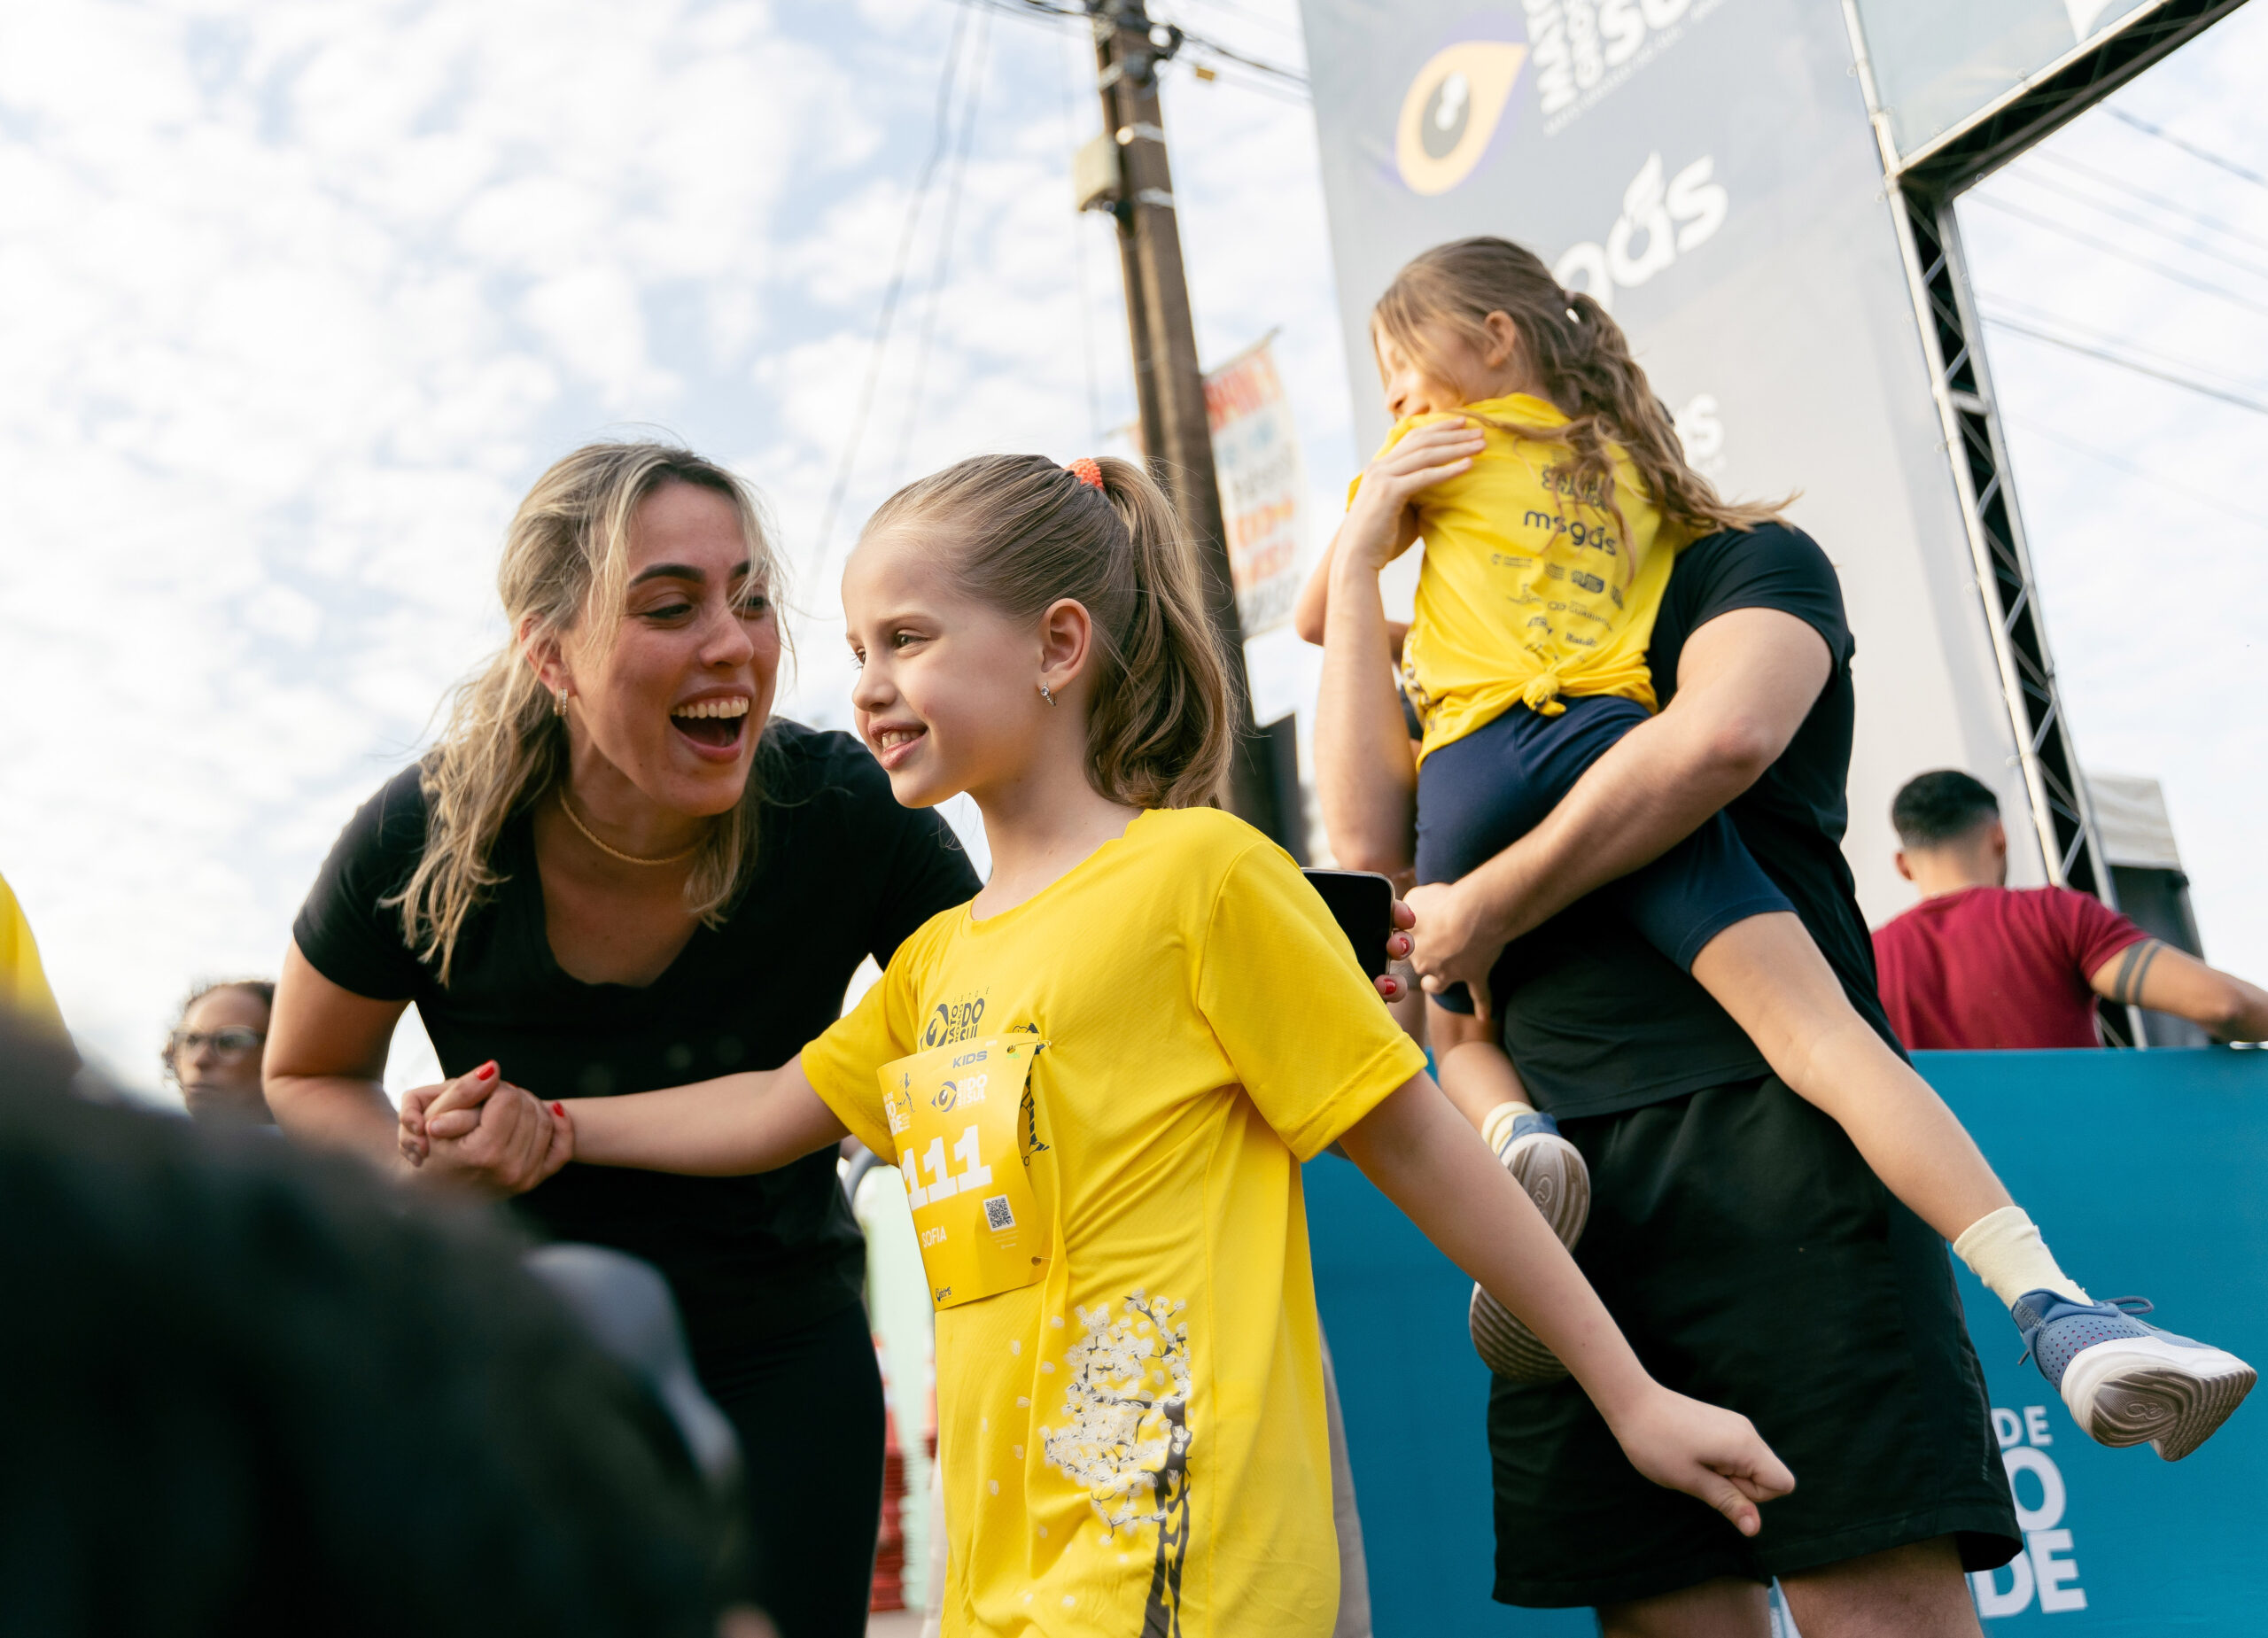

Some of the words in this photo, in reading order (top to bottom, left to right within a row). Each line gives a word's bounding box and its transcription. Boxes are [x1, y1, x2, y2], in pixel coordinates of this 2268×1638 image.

[961, 998, 984, 1027] DO
[952, 1050, 987, 1068] KIDS
[901, 1124, 992, 1211] 111
[921, 1225, 947, 1249] SOFIA
[1991, 1405, 2054, 1448] DE
[2000, 1446, 2067, 1532] O
[1969, 1528, 2088, 1619] DE
